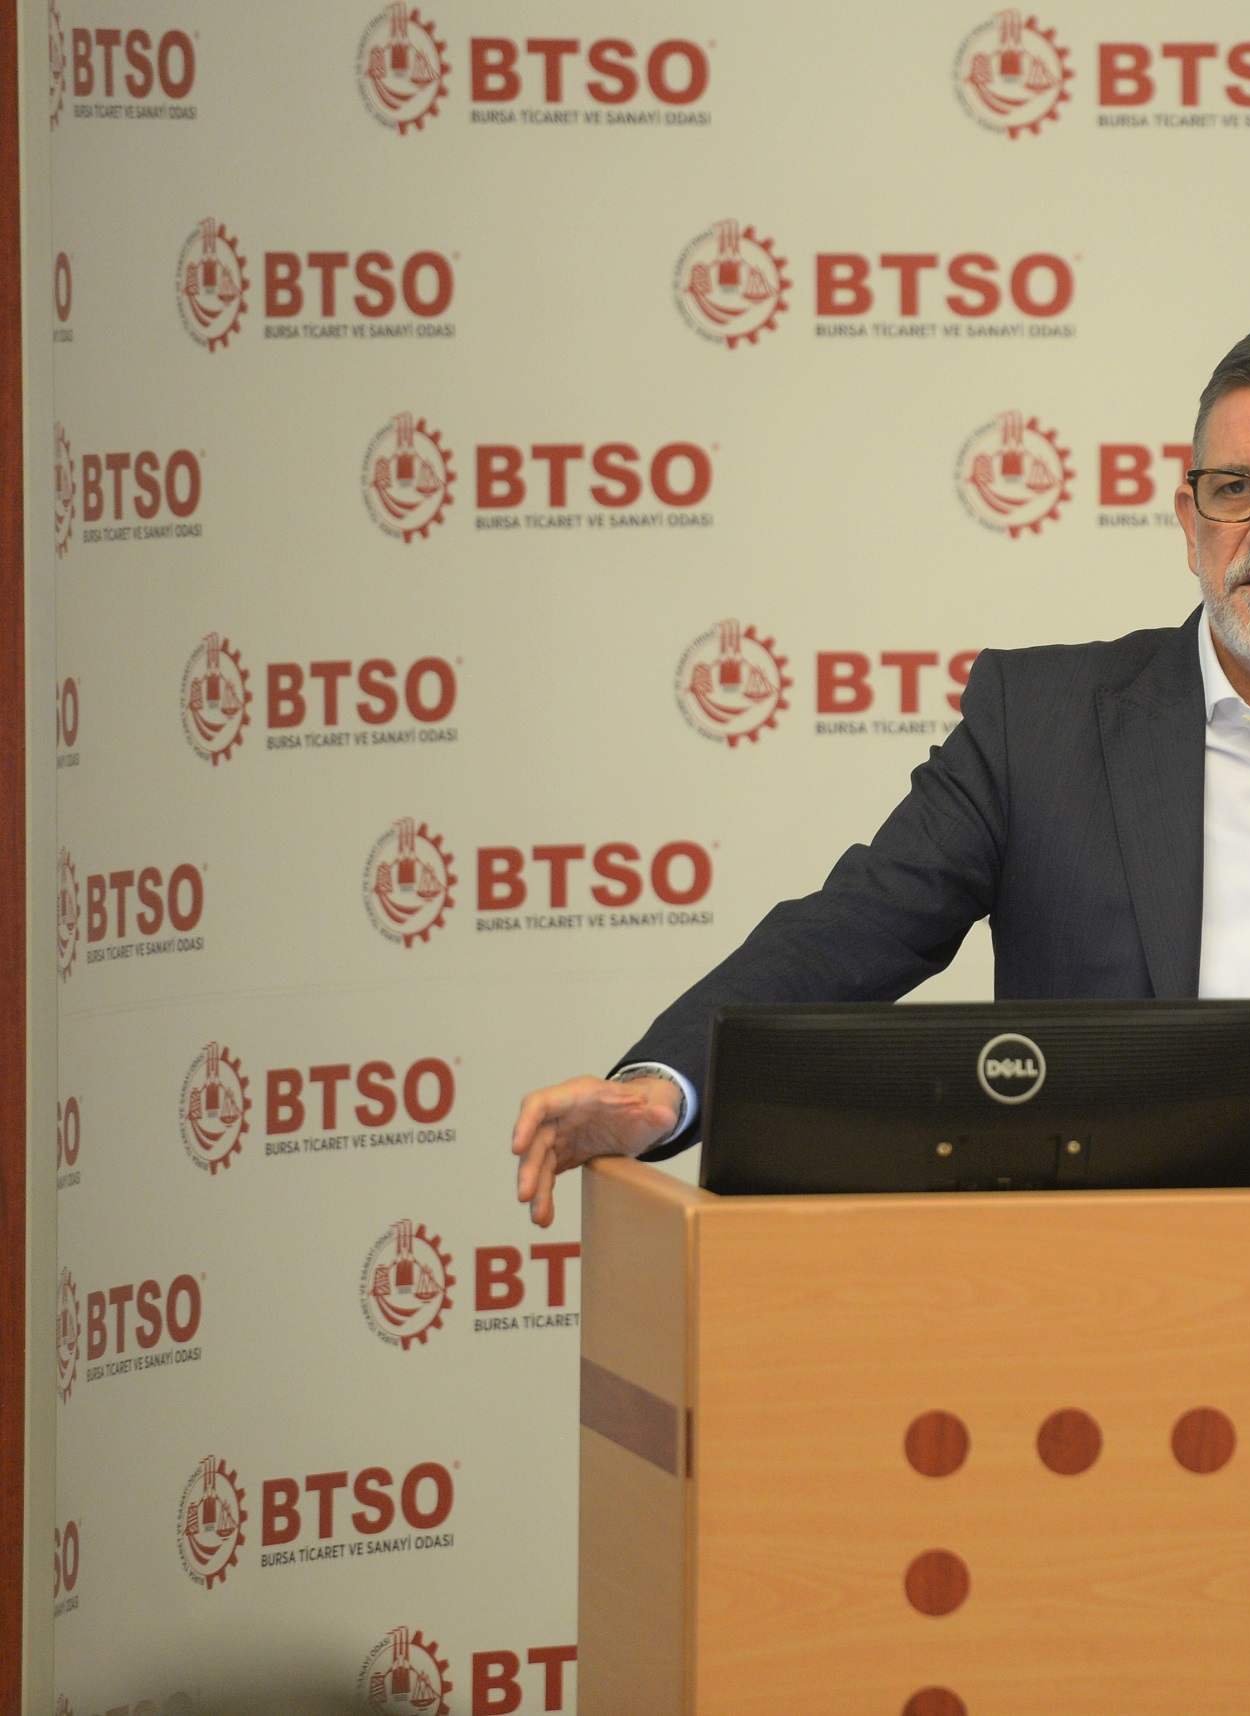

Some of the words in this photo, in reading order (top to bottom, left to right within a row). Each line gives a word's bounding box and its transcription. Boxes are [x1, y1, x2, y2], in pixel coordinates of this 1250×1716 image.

[72, 28, 196, 99] BTSO
[470, 38, 709, 105] BTSO
[265, 252, 453, 318] BTSO
[816, 253, 1074, 318] BTSO
[82, 450, 200, 522] BTSO
[476, 443, 712, 508] BTSO
[1099, 443, 1193, 507] BT
[268, 657, 457, 728] BTSO
[87, 863, 203, 943] BTSO
[477, 841, 712, 911] BTSO
[476, 917, 521, 931] BURSA
[667, 912, 714, 926] ODASI
[266, 1058, 455, 1135] BTSO
[986, 1058, 1039, 1079] DELL
[265, 1140, 300, 1156] BURSA
[417, 1129, 456, 1145] ODASI
[475, 1242, 581, 1311] BT
[87, 1274, 201, 1361] BTSO
[474, 1319, 519, 1332] BURSA
[523, 1311, 581, 1329] TİCARET
[262, 1462, 454, 1546] BTSO
[261, 1551, 296, 1568] BURSA
[299, 1546, 345, 1564] TİCARET
[367, 1536, 411, 1556] SANAYİ
[415, 1534, 454, 1551] ODASI
[472, 1645, 578, 1716] BT
